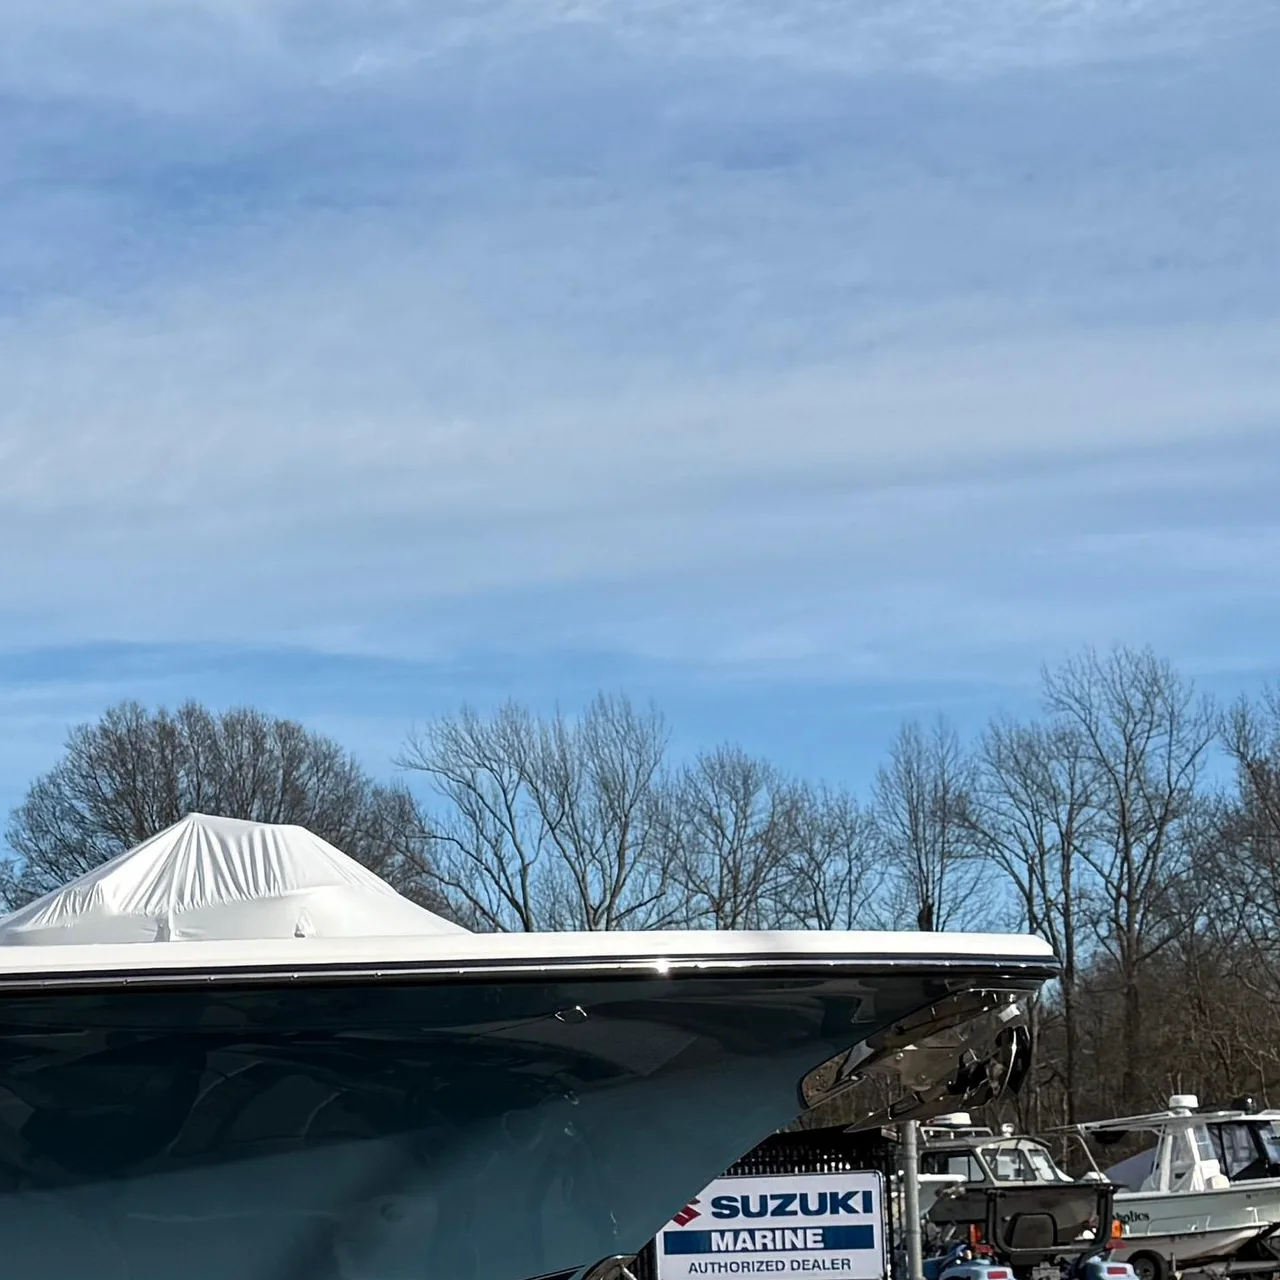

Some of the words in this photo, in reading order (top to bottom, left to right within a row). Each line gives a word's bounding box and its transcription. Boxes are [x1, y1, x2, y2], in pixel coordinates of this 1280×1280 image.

[710, 1190, 873, 1220] SUZUKI
[711, 1228, 825, 1252] MARINE
[688, 1258, 786, 1275] AUTHORIZED
[790, 1257, 852, 1272] DEALER
